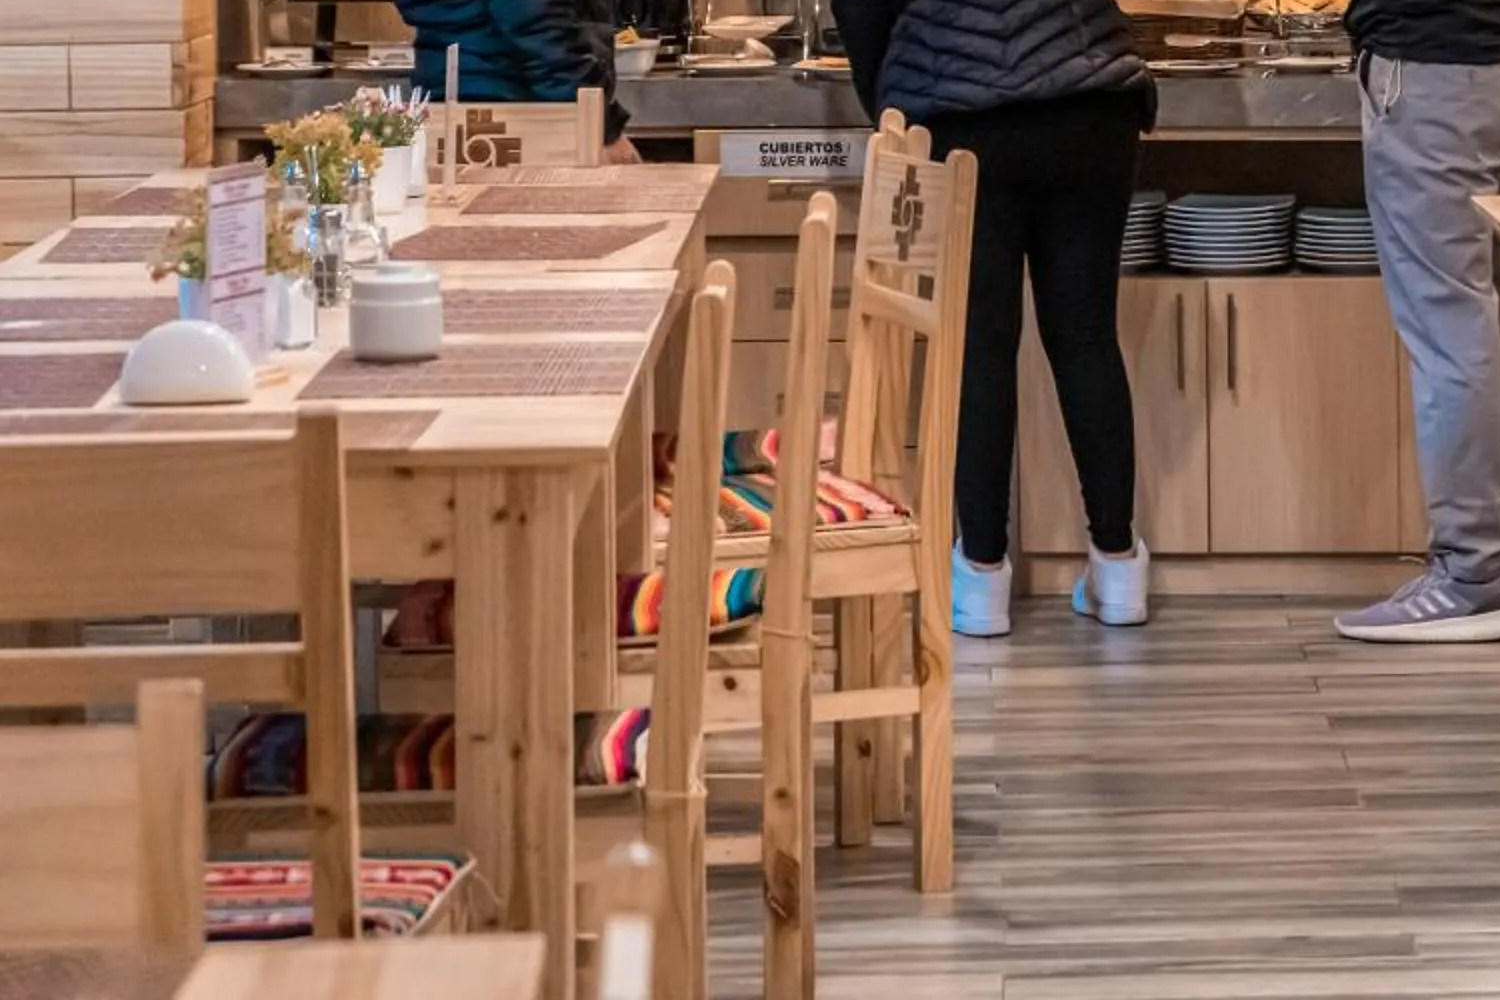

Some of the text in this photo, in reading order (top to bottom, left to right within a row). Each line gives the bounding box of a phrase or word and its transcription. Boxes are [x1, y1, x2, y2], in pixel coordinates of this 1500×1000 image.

[759, 142, 843, 153] CUBIERTOS
[760, 155, 849, 167] SILVER WARE
